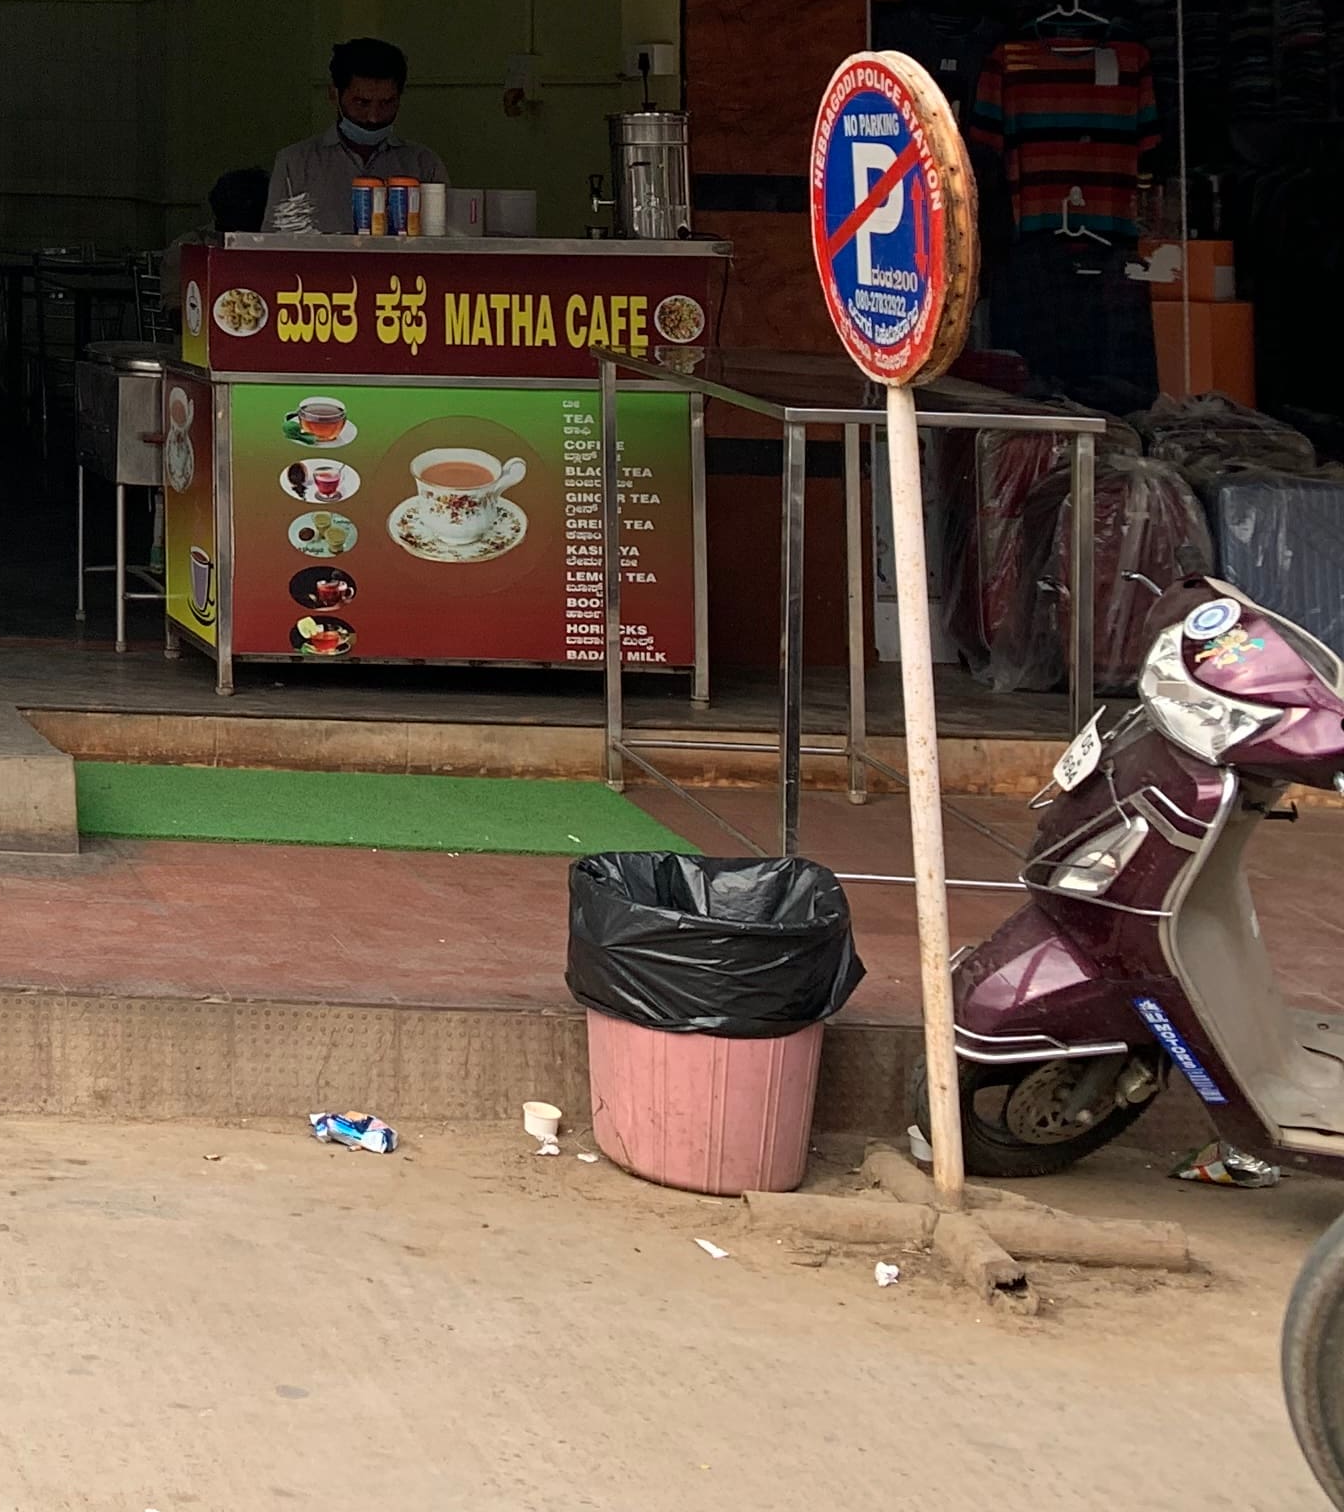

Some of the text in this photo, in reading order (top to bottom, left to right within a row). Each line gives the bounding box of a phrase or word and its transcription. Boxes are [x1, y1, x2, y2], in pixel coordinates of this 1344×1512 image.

[843, 113, 900, 137] NO PARKING
[814, 68, 943, 211] HEBBAGODI POLICE STATION
[444, 292, 649, 349] MATHA CAFE
[563, 413, 595, 424] TEA
[622, 467, 653, 477] TEA
[630, 494, 661, 504] TEA
[624, 520, 655, 530] TEA
[626, 572, 657, 583] TEA
[627, 651, 667, 662] MILK
